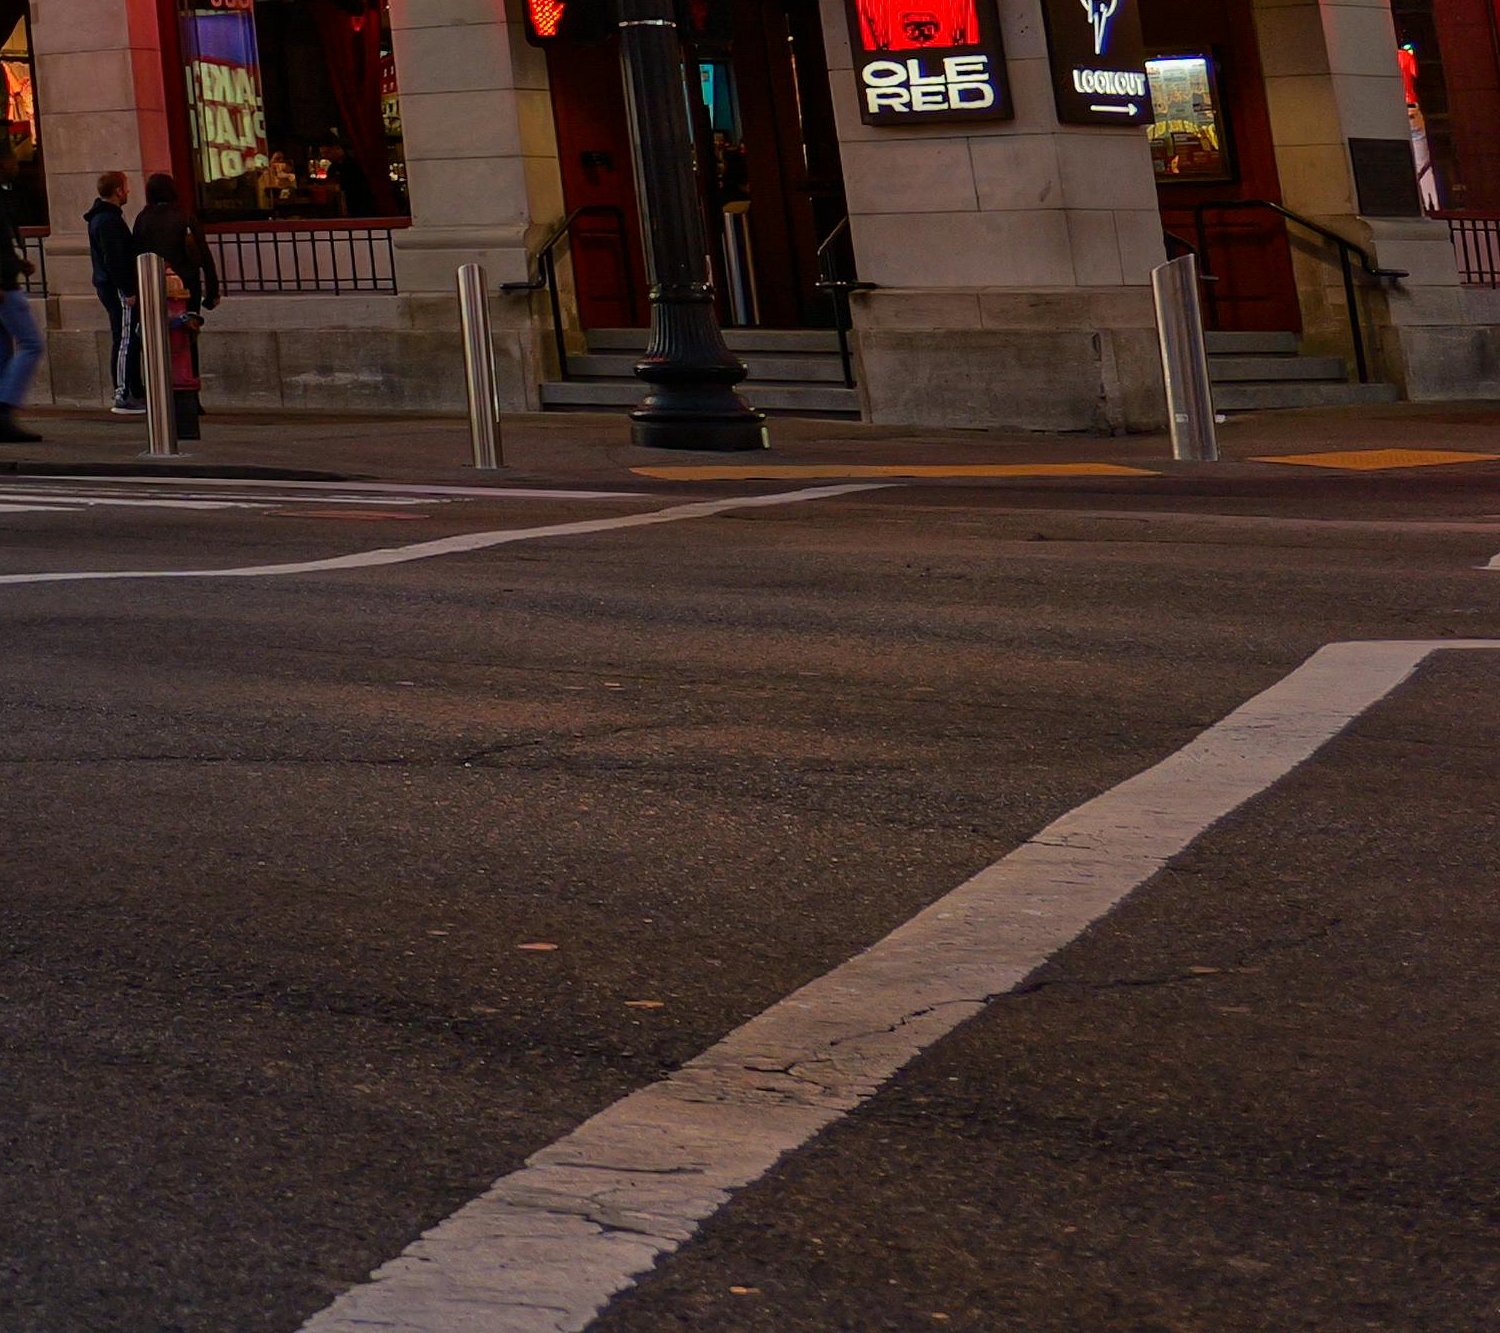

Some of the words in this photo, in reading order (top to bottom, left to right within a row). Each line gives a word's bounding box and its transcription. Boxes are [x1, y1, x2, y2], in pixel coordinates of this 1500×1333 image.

[860, 55, 990, 88] OLE
[1072, 69, 1147, 96] LOOKOUT
[865, 82, 995, 115] RED
